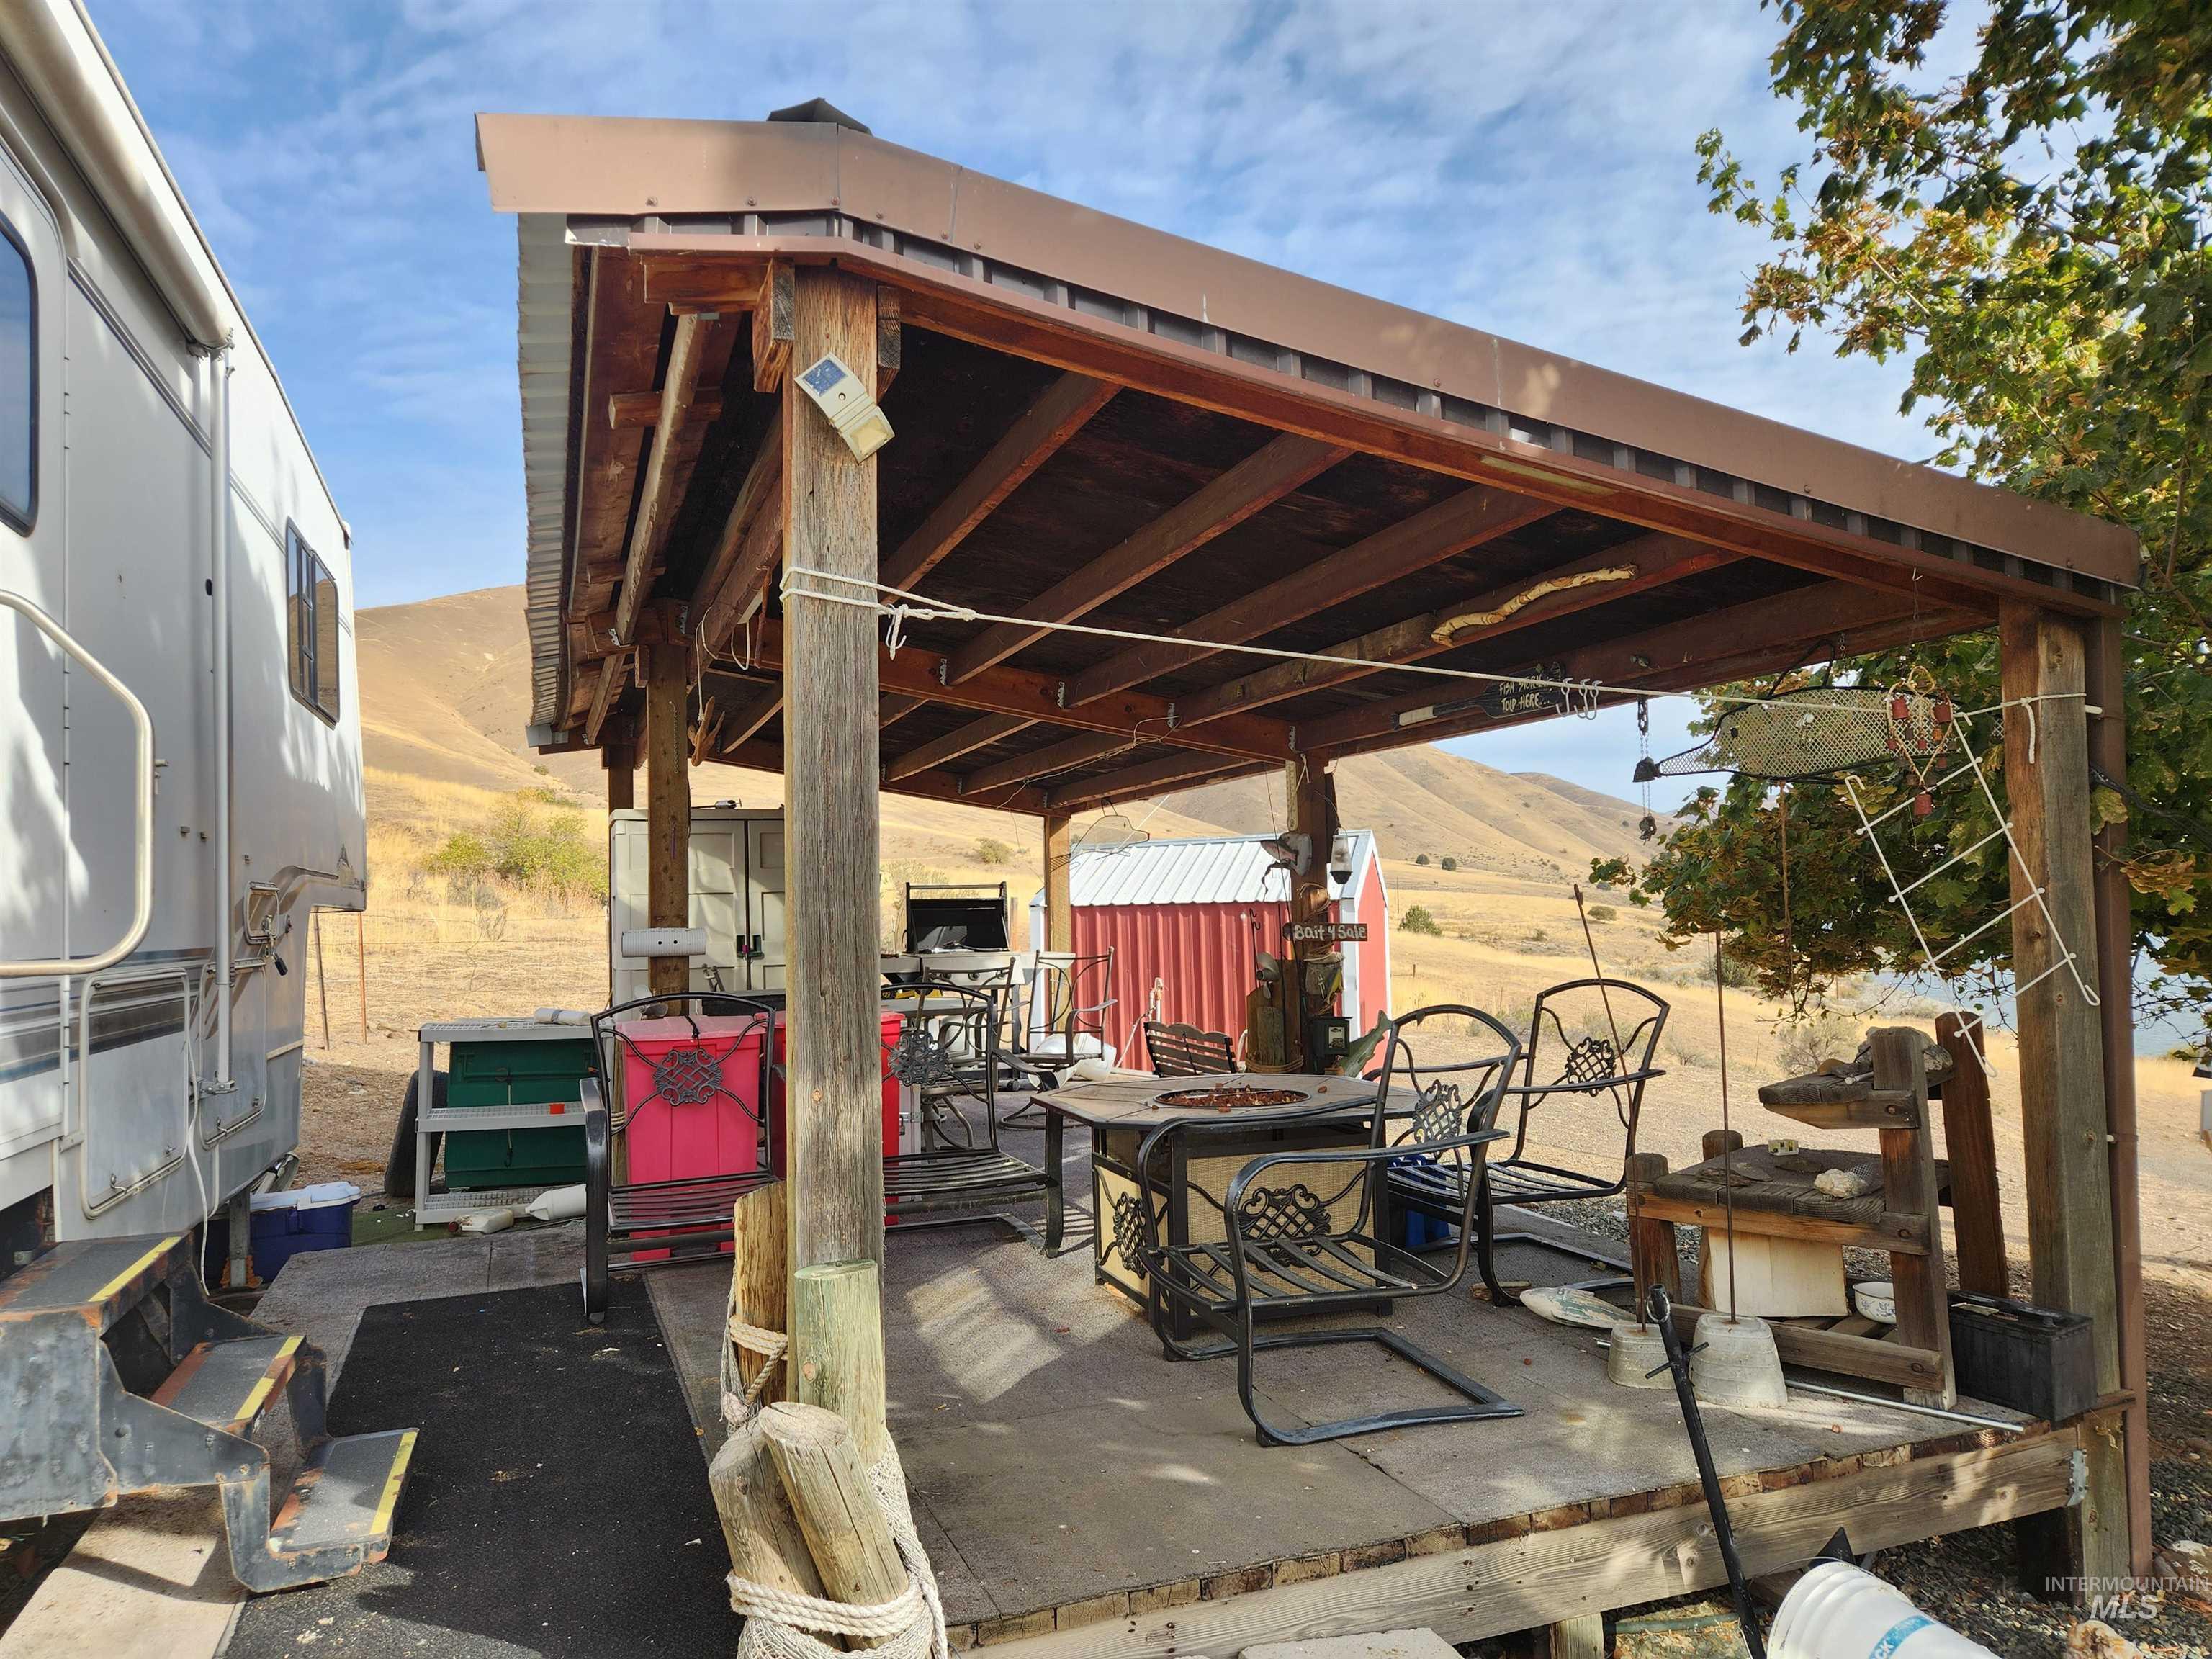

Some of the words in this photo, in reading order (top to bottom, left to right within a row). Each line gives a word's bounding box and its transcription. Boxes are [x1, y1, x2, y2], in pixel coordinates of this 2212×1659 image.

[1499, 680, 1514, 696] FISH
[1518, 674, 1547, 692] STOR
[1501, 697, 1516, 712] TOLD
[1293, 924, 1325, 940] Bait
[1328, 927, 1335, 940] 4
[1338, 925, 1366, 940] Sale
